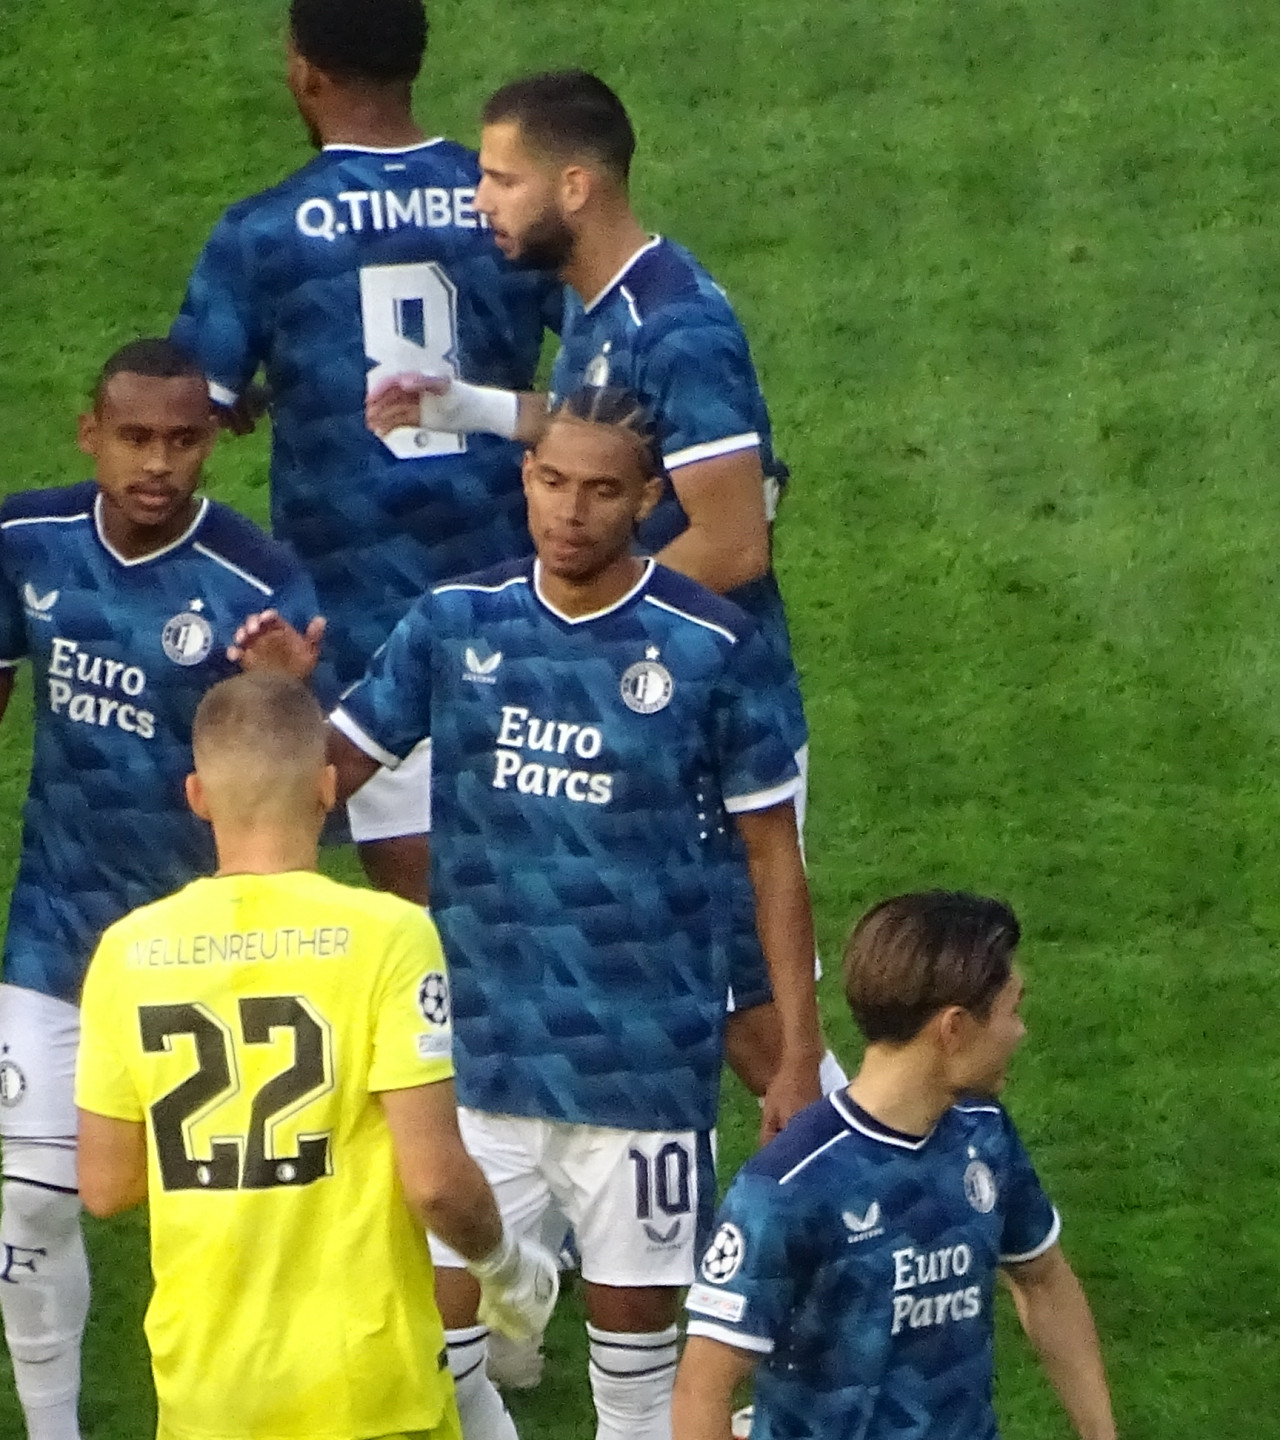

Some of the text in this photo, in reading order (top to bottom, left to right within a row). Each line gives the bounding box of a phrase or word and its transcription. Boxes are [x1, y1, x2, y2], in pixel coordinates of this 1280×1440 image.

[359, 261, 468, 460] 8
[48, 636, 147, 697] Euro
[48, 678, 156, 739] Parcs
[496, 705, 602, 759] Euro
[492, 749, 612, 805] Parcs
[138, 995, 334, 1192] 22
[628, 1141, 692, 1220] 10
[892, 1243, 971, 1291] Euro
[891, 1285, 982, 1337] Parcs
